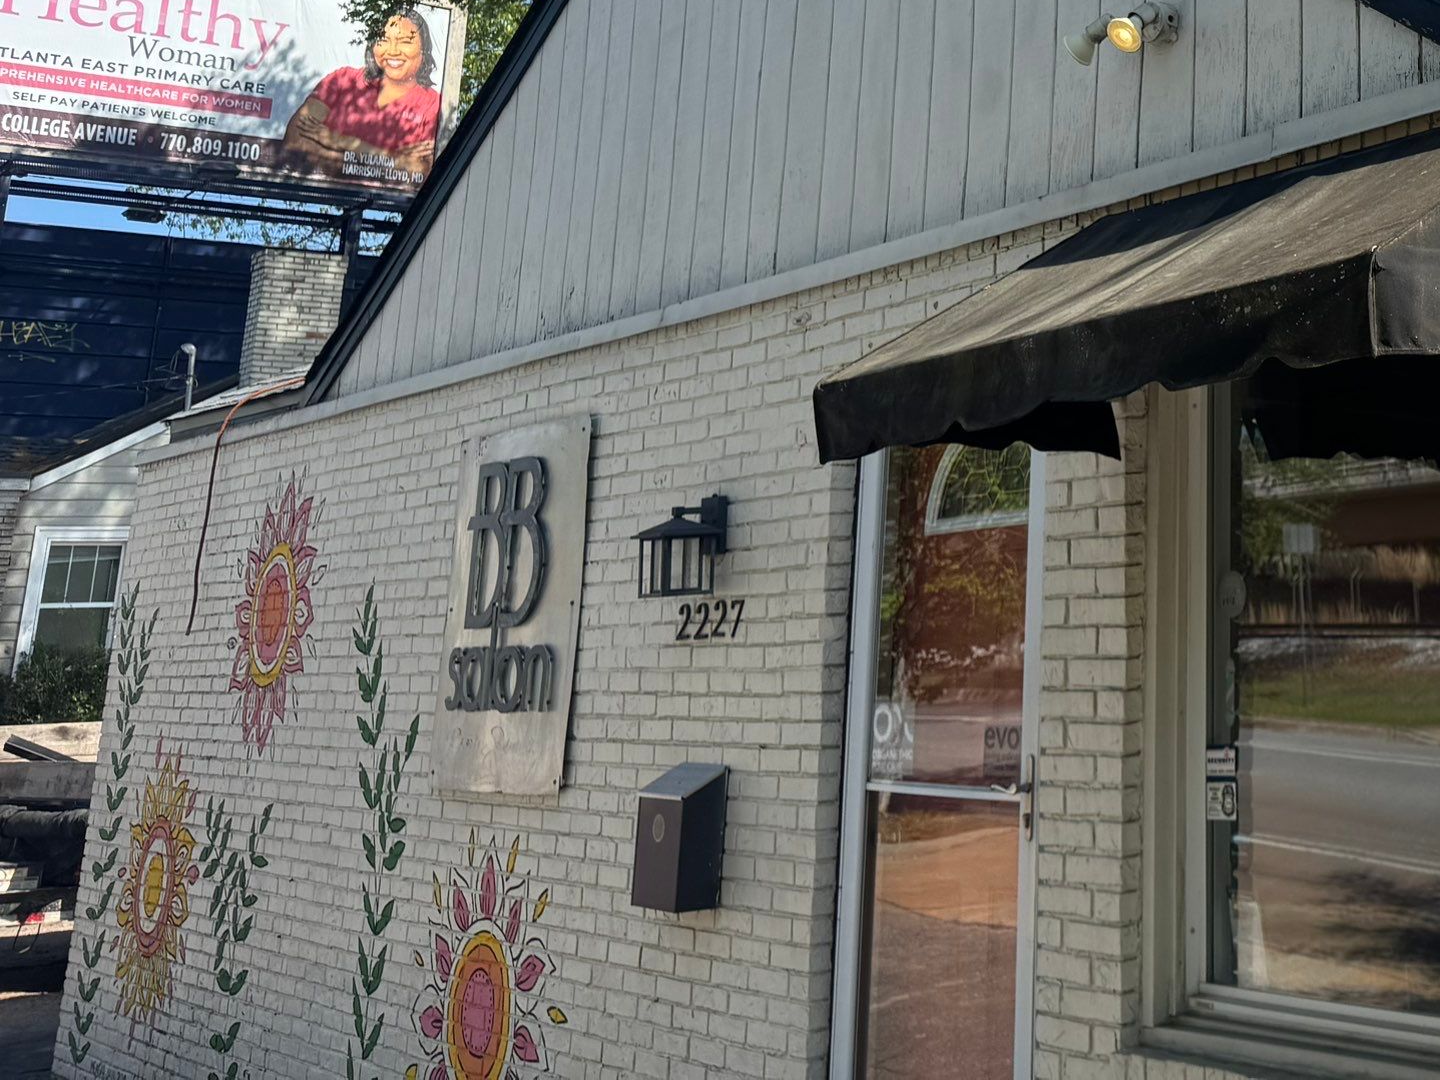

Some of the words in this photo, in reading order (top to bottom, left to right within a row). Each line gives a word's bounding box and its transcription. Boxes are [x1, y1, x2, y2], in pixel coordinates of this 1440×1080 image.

[128, 35, 237, 72] Woman
[81, 58, 128, 75] EAST
[134, 65, 214, 86] PRIMARY
[220, 78, 266, 94] CARE
[12, 91, 46, 103] SELF
[50, 96, 77, 108] PAY
[81, 100, 146, 117] PATIENTS
[150, 109, 216, 126] WELCOME
[90, 81, 178, 101] HEALTHCARE
[181, 92, 208, 105] FOR
[212, 96, 261, 112] WOMEN
[2, 113, 71, 139] COLLEGE
[73, 122, 138, 146] AVENUE
[161, 132, 260, 161] 770.809.1100
[344, 151, 357, 162] DR.
[411, 170, 424, 183] MD
[465, 456, 548, 629] BB
[676, 600, 745, 640] 2227
[445, 601, 552, 712] salon
